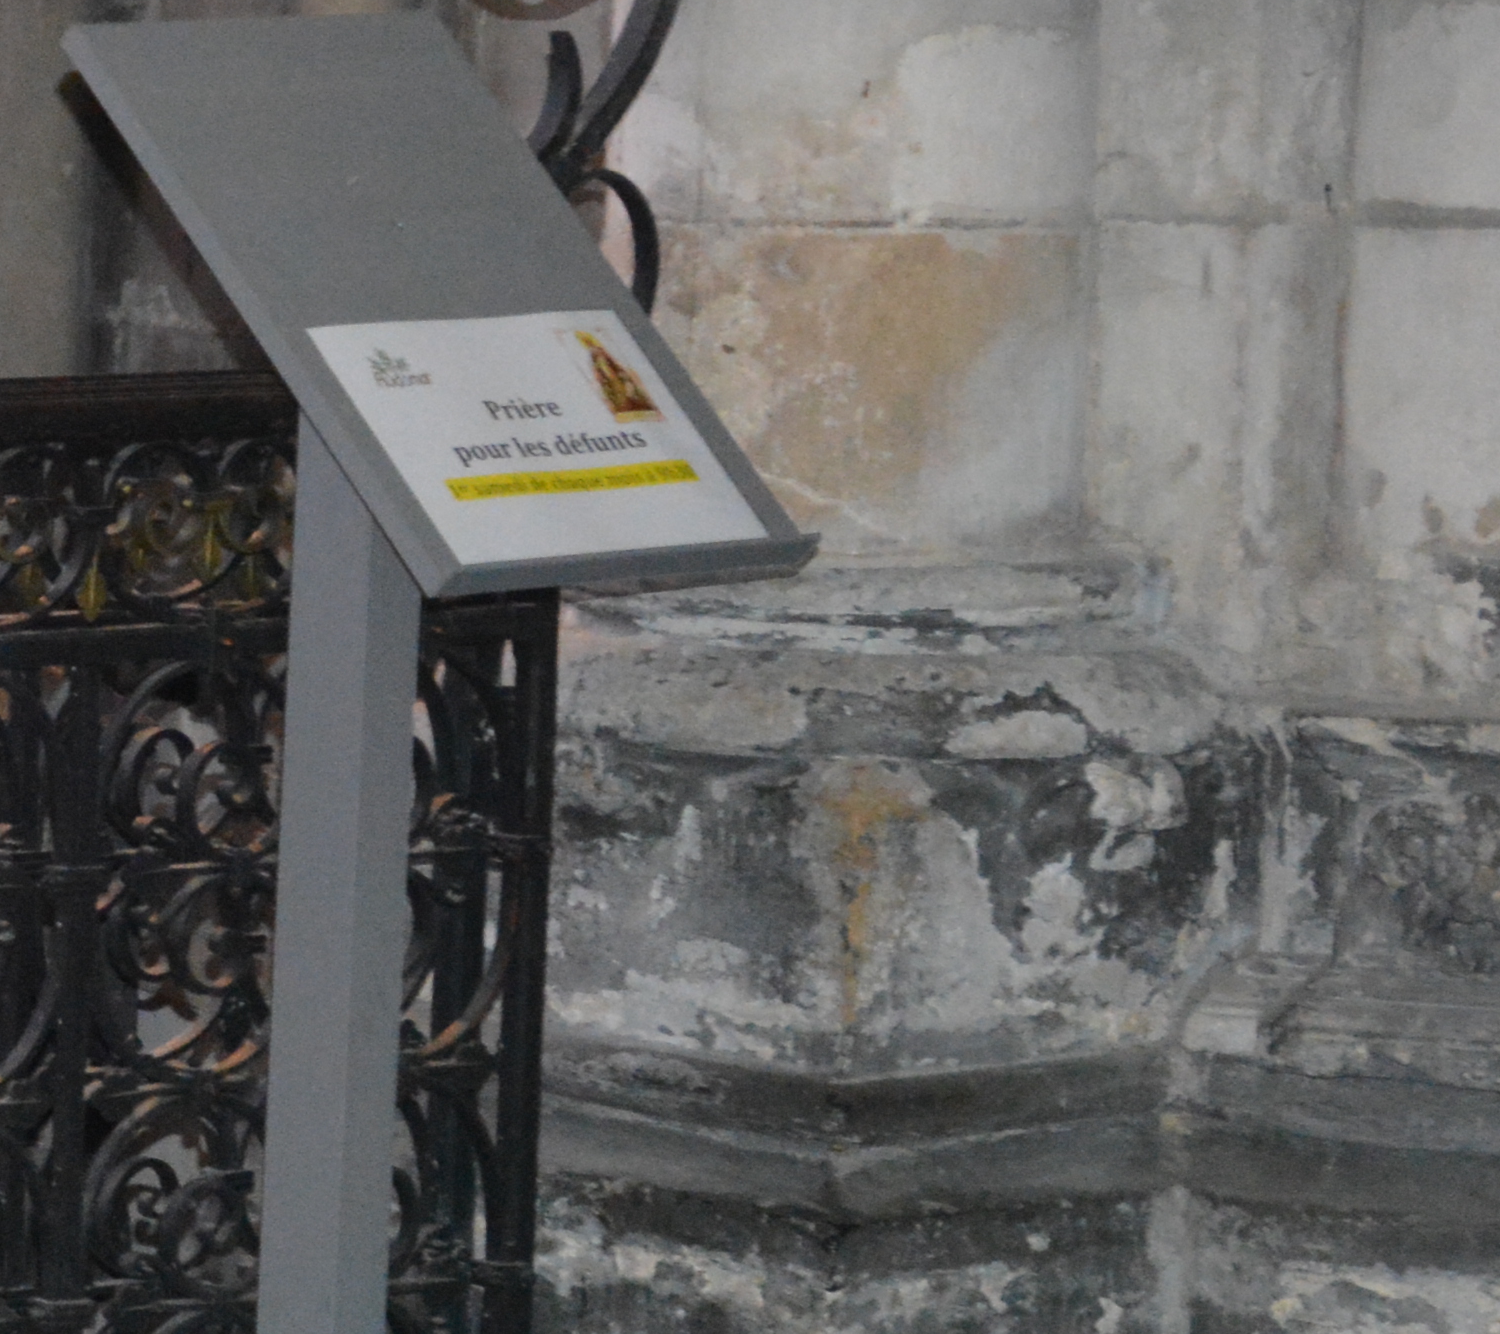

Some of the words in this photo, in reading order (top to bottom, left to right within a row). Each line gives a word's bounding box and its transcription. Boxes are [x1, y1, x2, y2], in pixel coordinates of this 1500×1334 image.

[482, 397, 564, 422] Prière
[453, 443, 513, 468] pour
[513, 437, 552, 460] les
[553, 429, 648, 457] défunts
